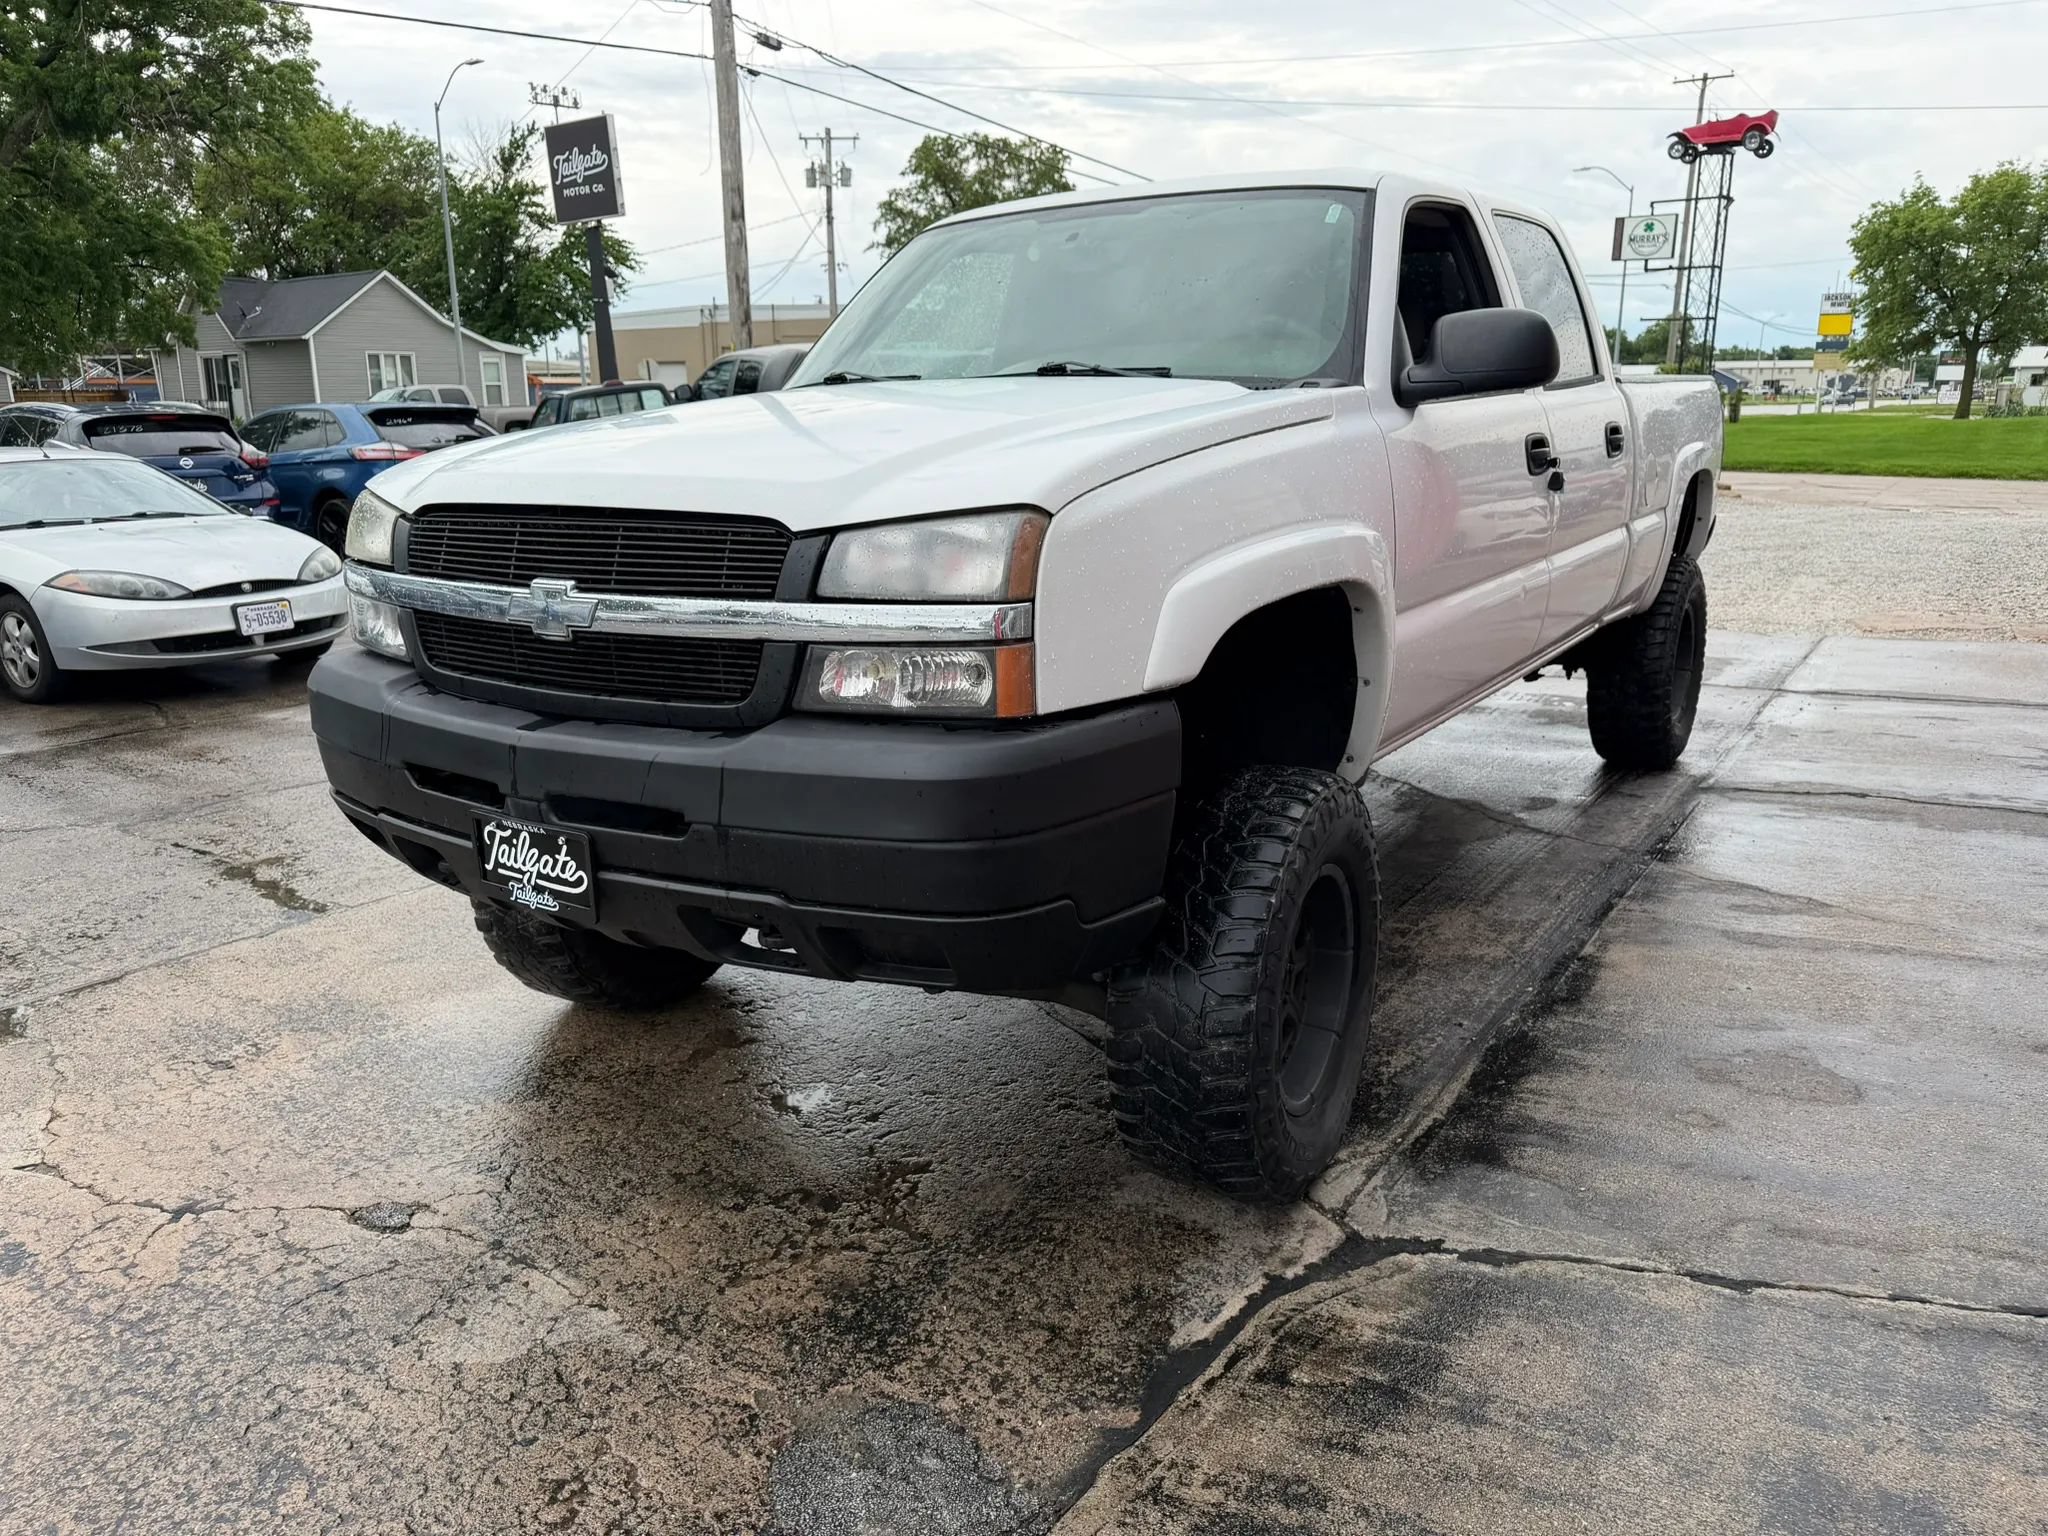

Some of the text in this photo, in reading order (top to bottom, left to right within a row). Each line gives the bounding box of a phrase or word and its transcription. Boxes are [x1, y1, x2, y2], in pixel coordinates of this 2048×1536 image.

[553, 143, 608, 186] Tailgate
[563, 184, 605, 198] MOTOR CO.
[1824, 293, 1851, 301] JACKSON
[244, 609, 288, 629] 5-D5538
[501, 819, 547, 835] NEBRASKA
[484, 822, 588, 894] Tailgate
[509, 882, 560, 911] Tailgate
